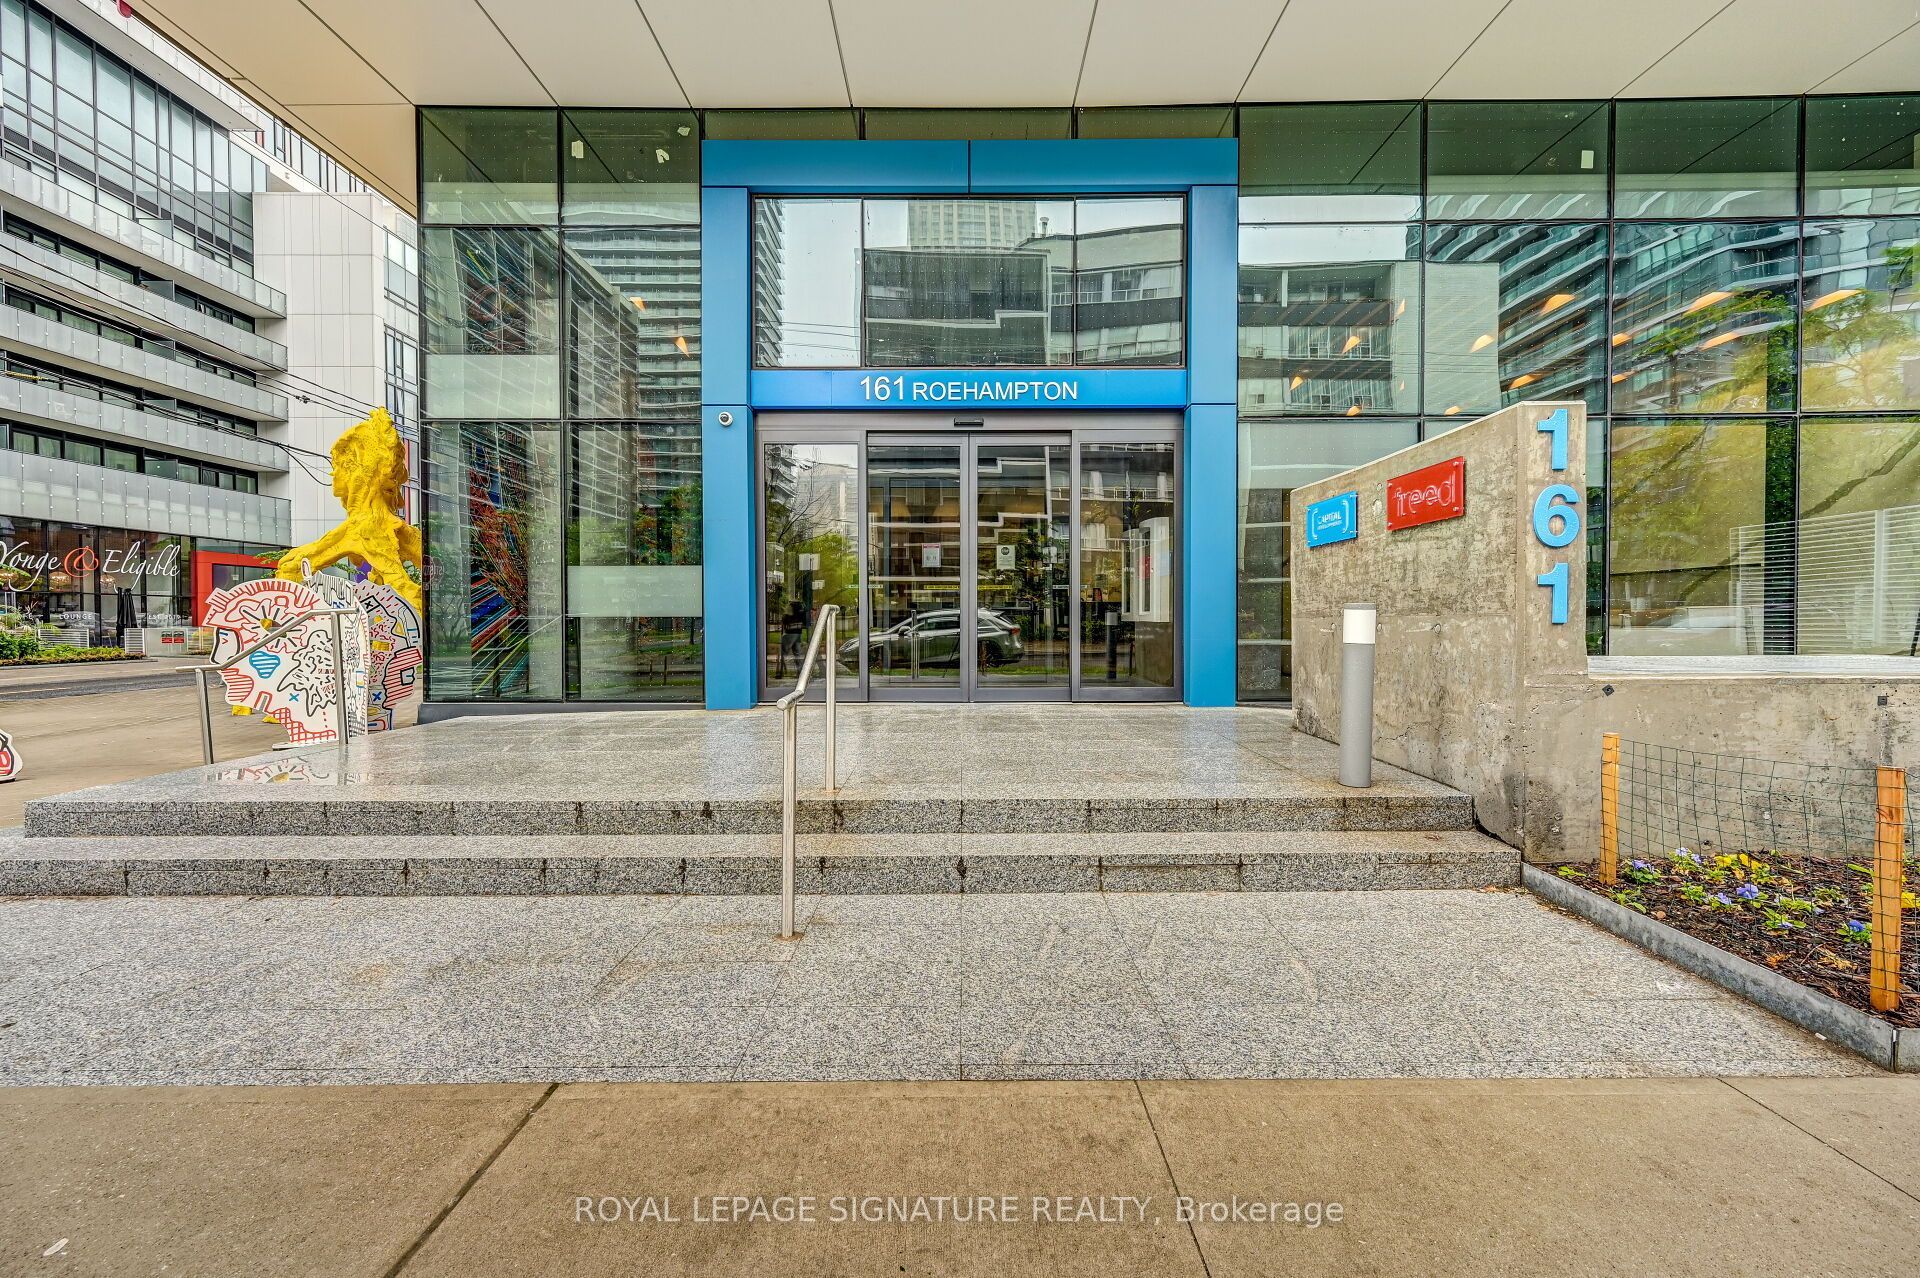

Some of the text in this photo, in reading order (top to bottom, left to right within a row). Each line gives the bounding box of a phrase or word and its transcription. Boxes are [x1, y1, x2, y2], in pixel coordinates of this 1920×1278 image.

[860, 376, 1078, 400] 161 ROEHAMPTON
[0, 541, 61, 592] Yonge
[103, 539, 181, 593] Eligible
